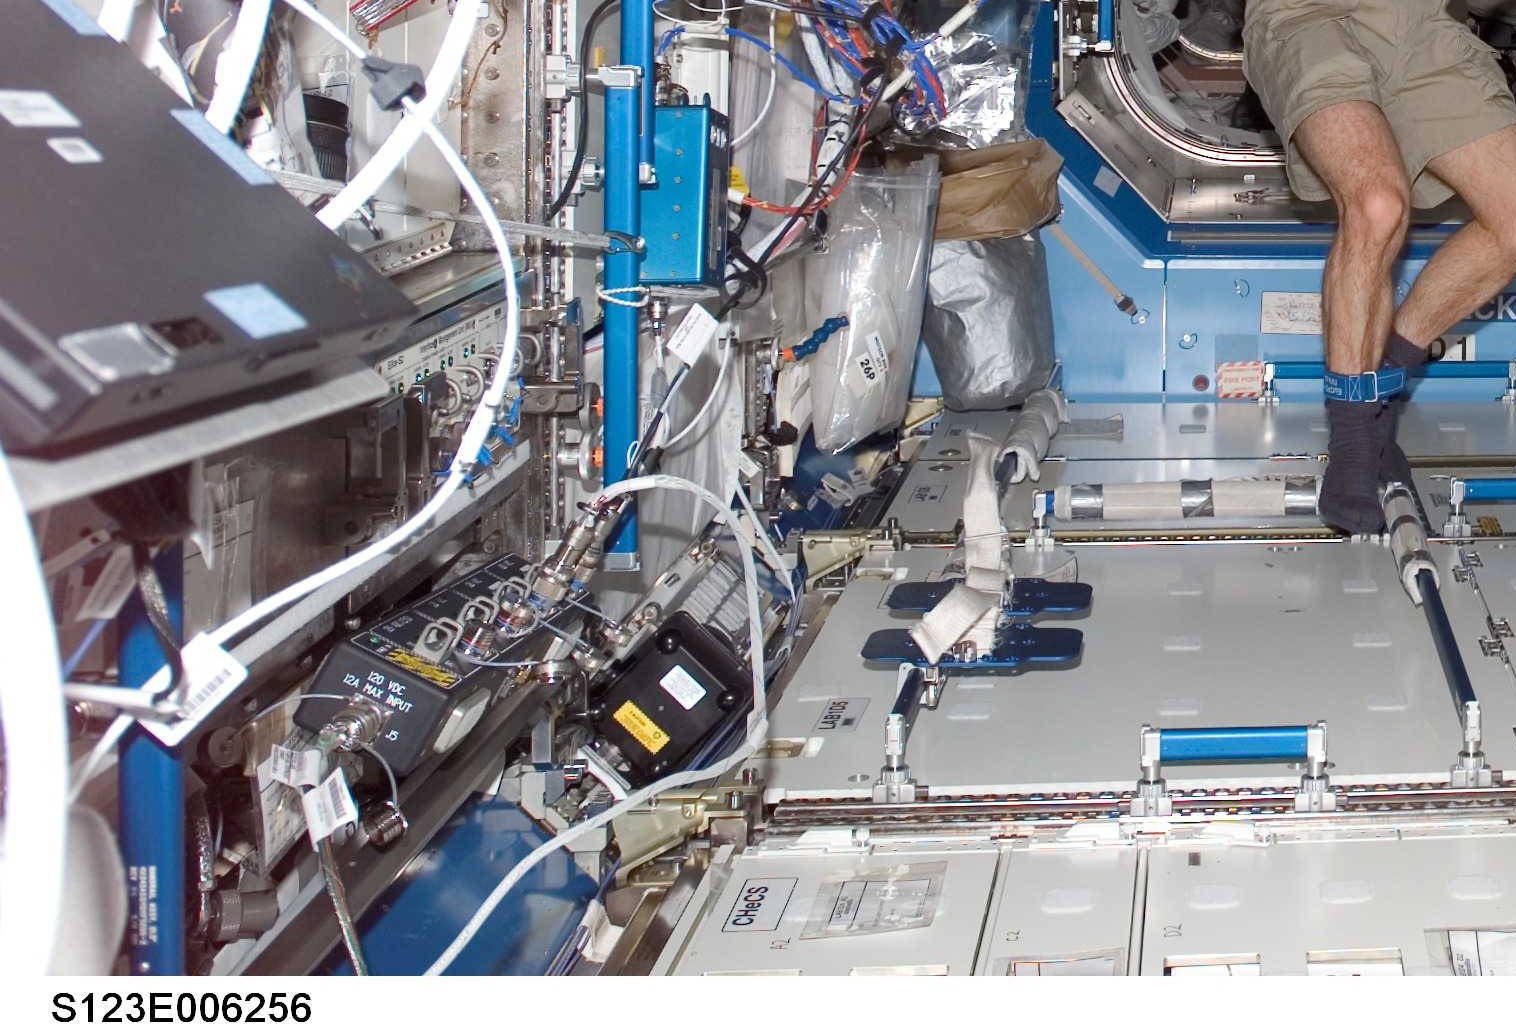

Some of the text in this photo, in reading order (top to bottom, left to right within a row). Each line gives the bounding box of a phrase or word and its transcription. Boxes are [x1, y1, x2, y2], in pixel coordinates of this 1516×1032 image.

[860, 358, 876, 380] 26P
[343, 673, 413, 714] 12A MAX INPUT
[368, 670, 407, 697] 120 VDC
[817, 701, 850, 731] LAB1D5
[731, 886, 769, 928] CHeCS
[1006, 929, 1021, 943] C2
[1163, 923, 1182, 938] D2
